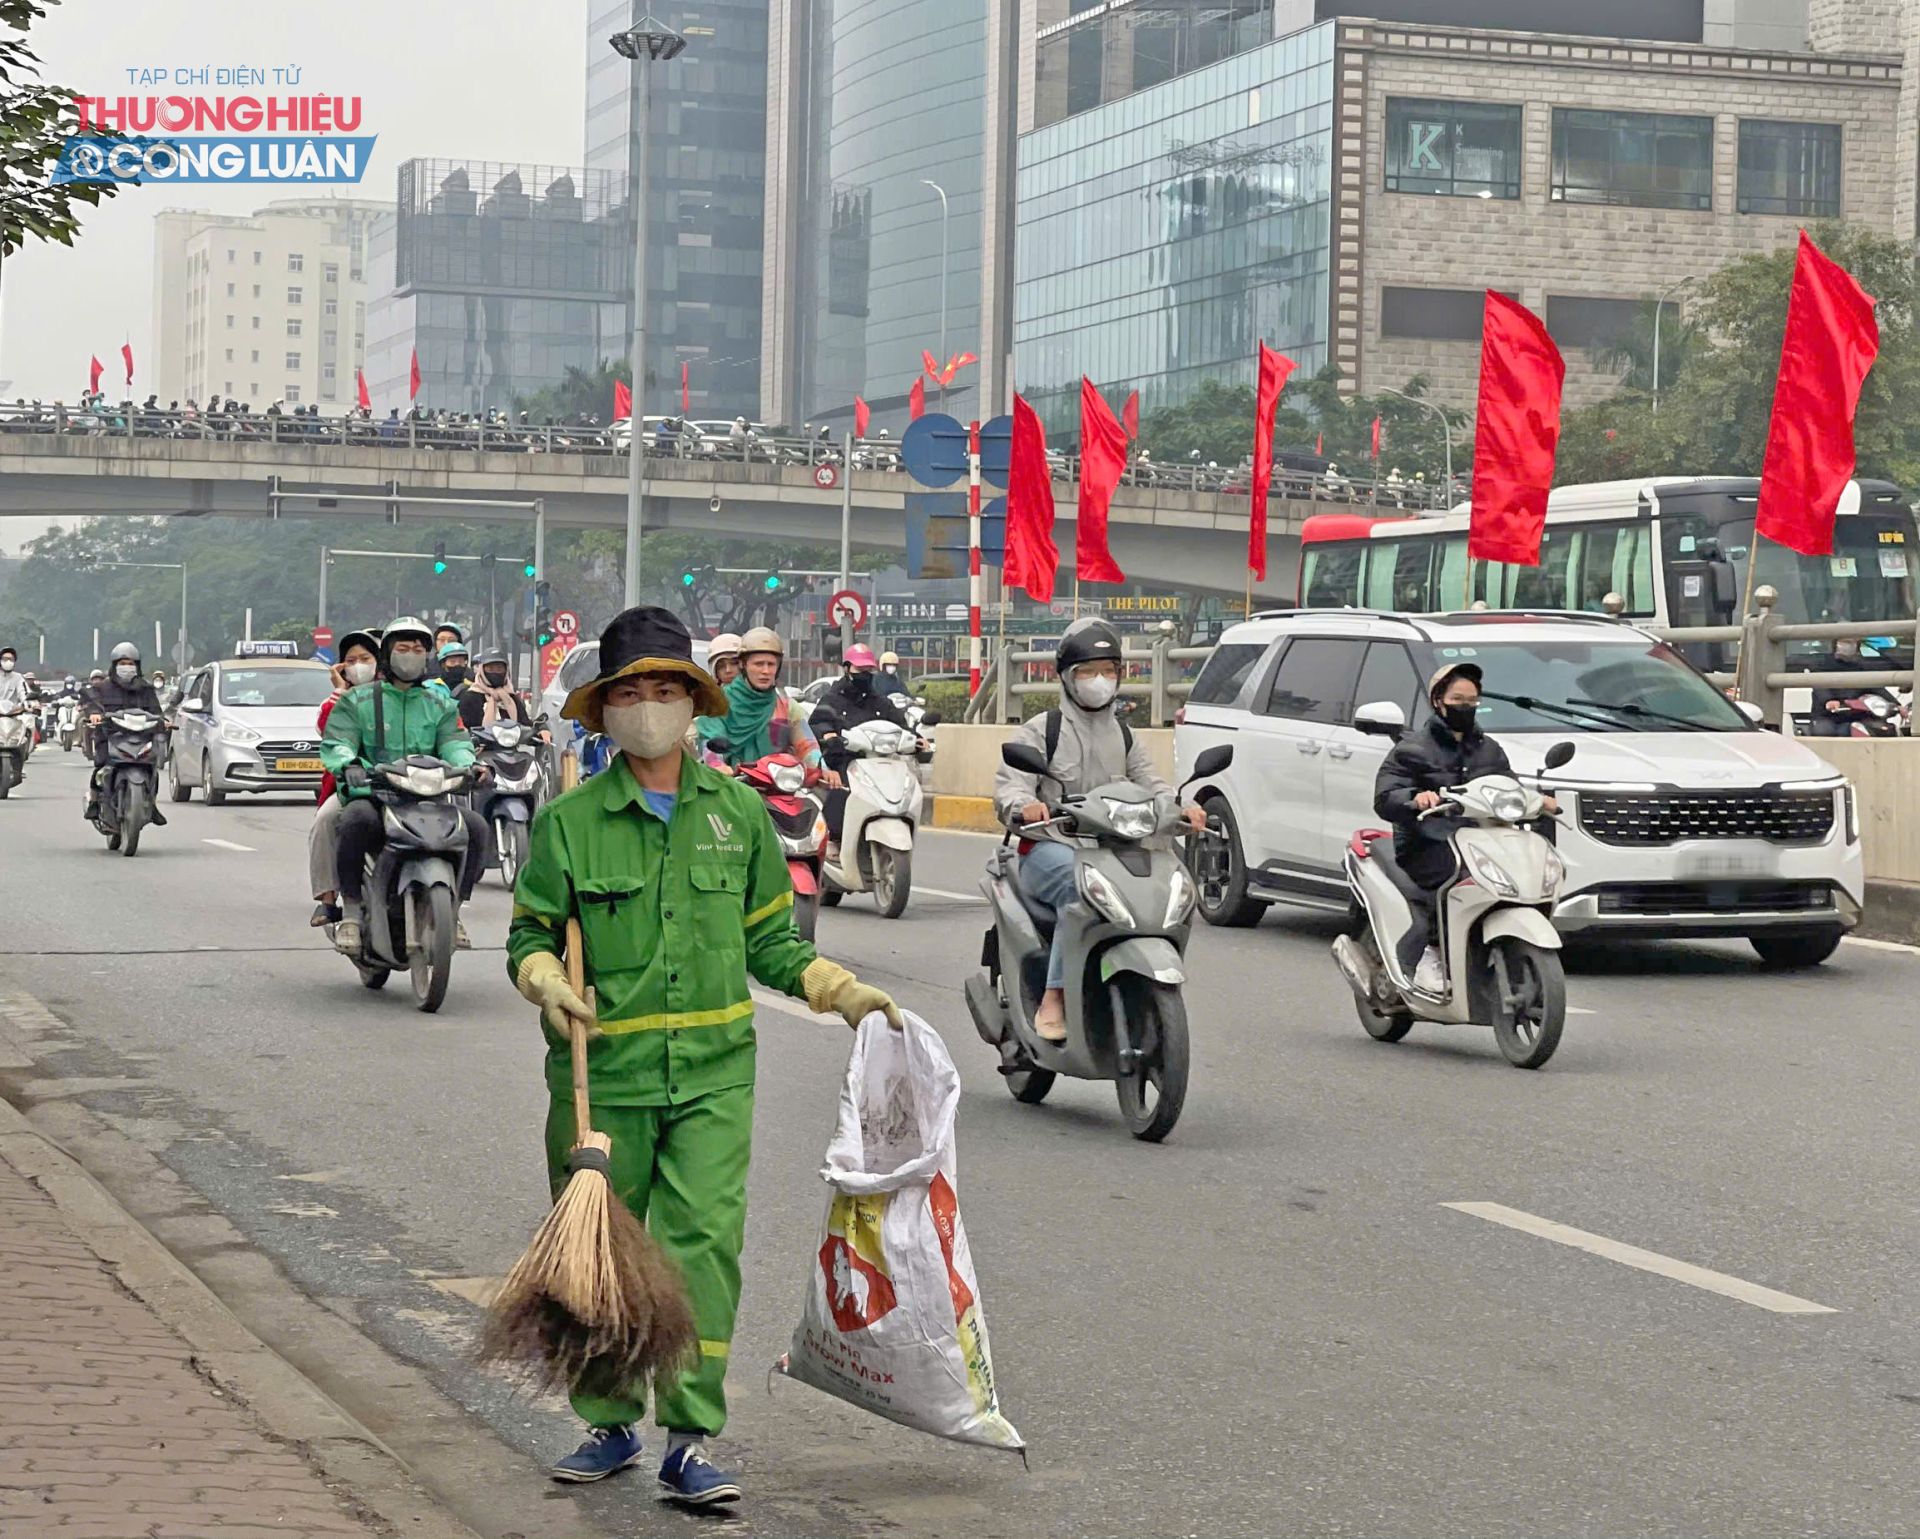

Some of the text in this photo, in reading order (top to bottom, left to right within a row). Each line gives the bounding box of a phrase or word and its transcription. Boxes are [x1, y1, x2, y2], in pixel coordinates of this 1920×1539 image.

[1455, 123, 1464, 136] K
[1407, 121, 1446, 170] K
[1455, 143, 1504, 160] Swimming
[1107, 597, 1180, 610] THE PILOT
[850, 1360, 895, 1384] Max
